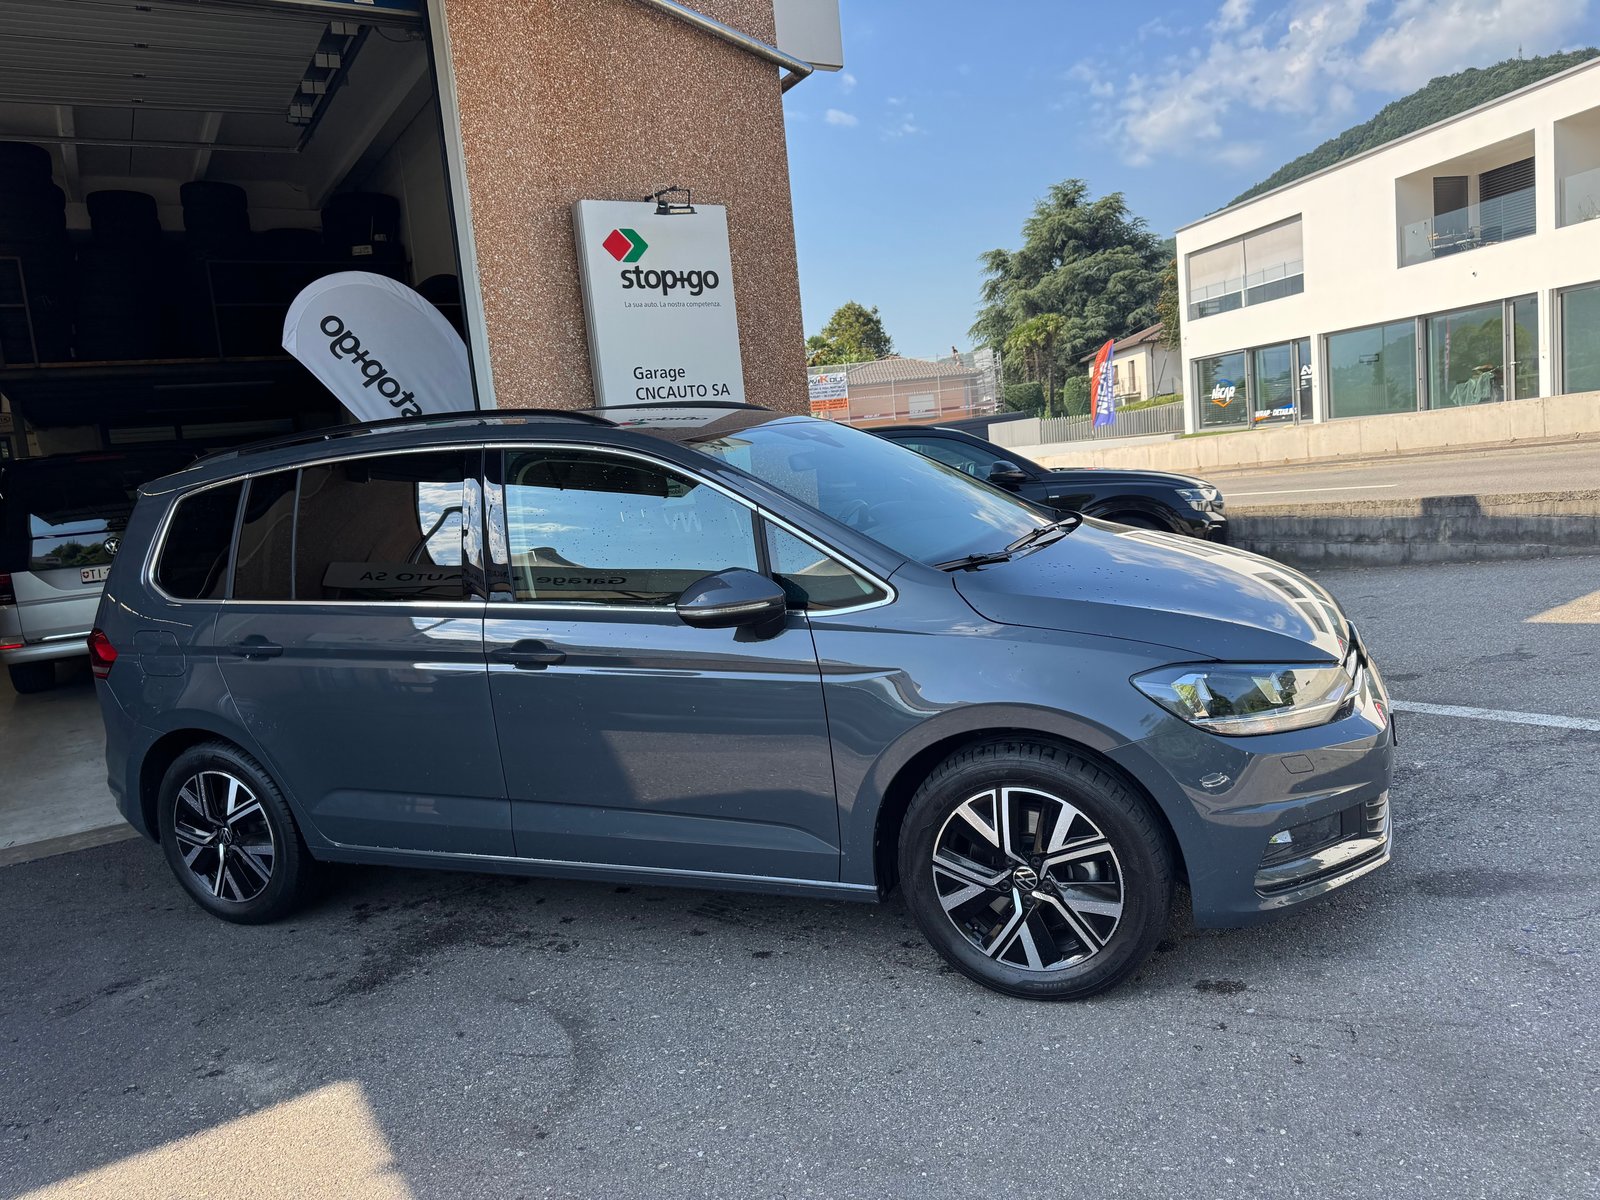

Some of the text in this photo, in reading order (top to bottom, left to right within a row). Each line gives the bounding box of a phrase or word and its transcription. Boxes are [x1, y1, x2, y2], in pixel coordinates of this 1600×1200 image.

[621, 265, 719, 296] stop+go
[686, 301, 722, 309] competenza.
[633, 366, 686, 382] Garage
[635, 383, 731, 400] CNCAUTO SA
